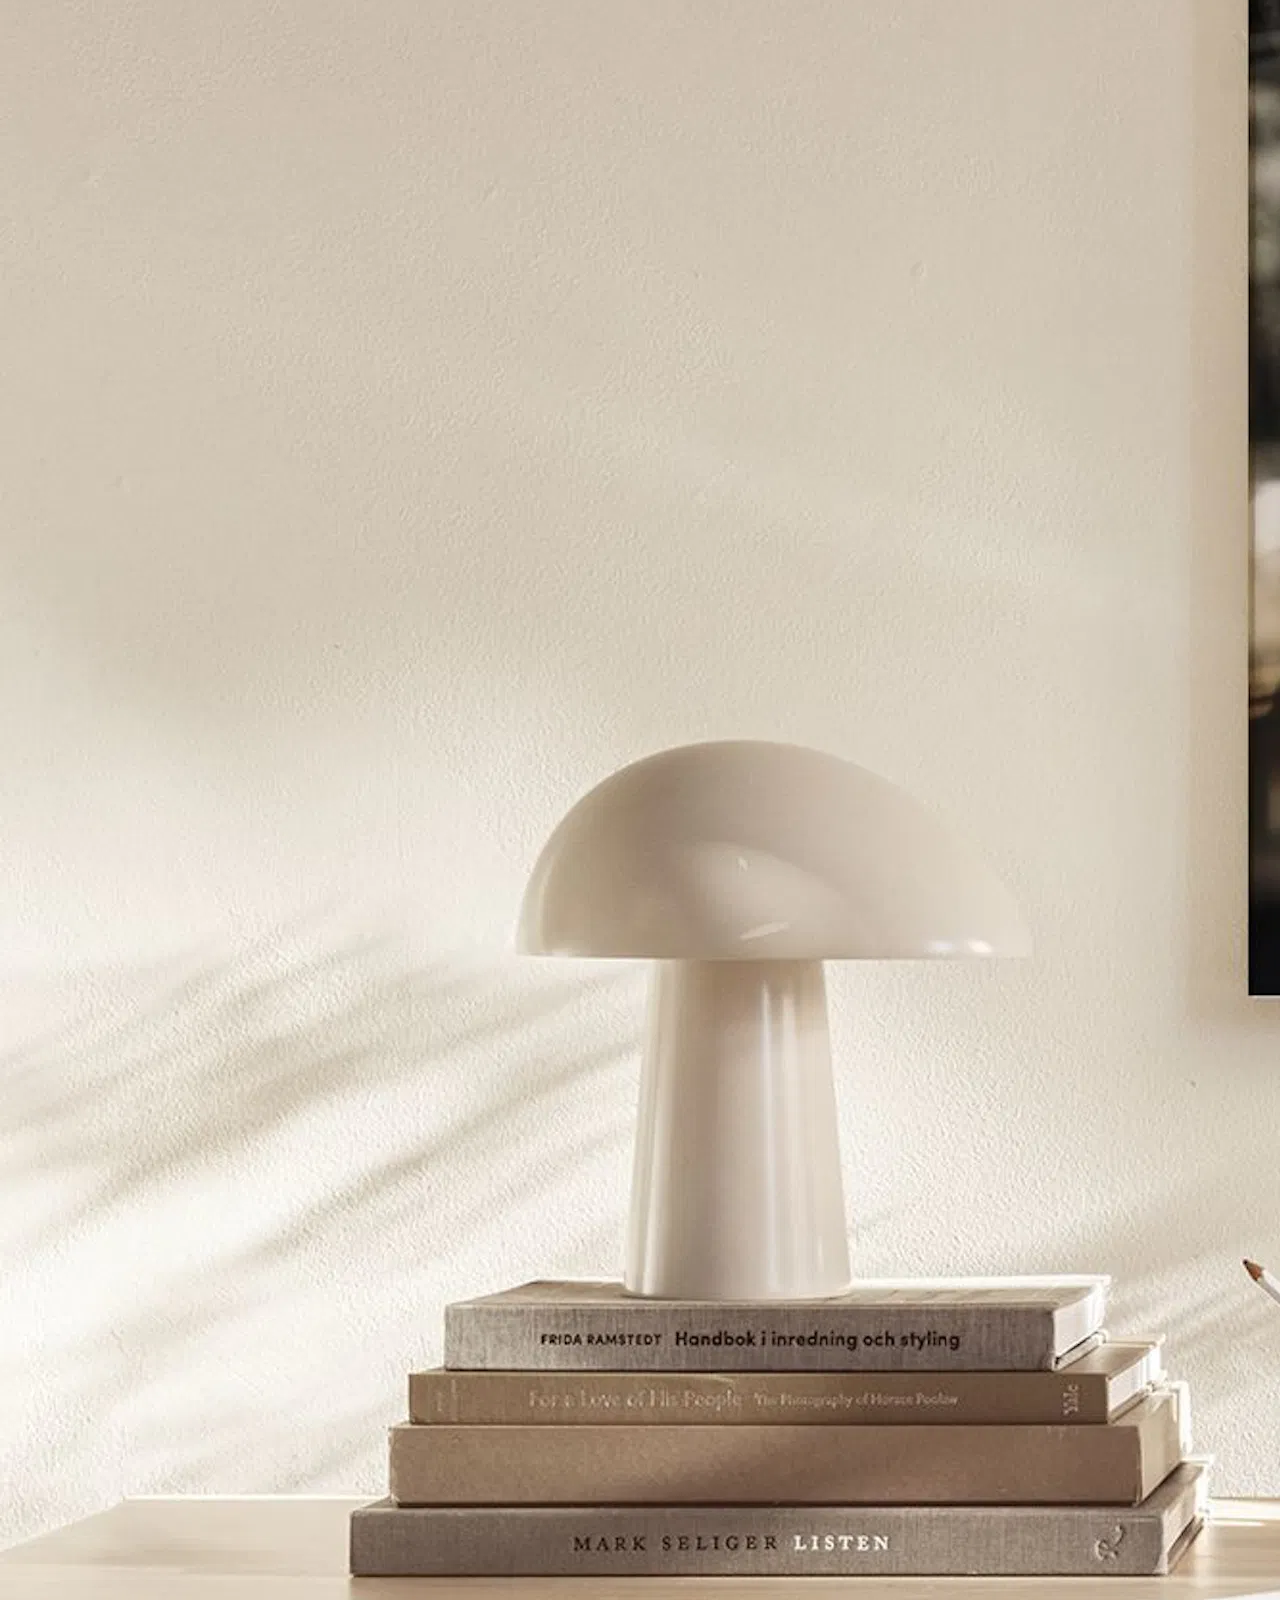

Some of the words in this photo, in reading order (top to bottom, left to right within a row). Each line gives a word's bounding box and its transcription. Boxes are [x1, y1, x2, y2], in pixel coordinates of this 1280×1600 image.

[541, 1333, 582, 1346] FRIDA
[587, 1333, 661, 1346] RAMSTEDT
[675, 1331, 756, 1346] Handbok
[761, 1331, 767, 1346] i
[772, 1331, 857, 1350] inredning
[863, 1331, 894, 1346] och
[900, 1331, 960, 1350] styling
[573, 1535, 647, 1551] MARK
[662, 1535, 778, 1551] SELIGER
[794, 1534, 890, 1551] LISTEN
